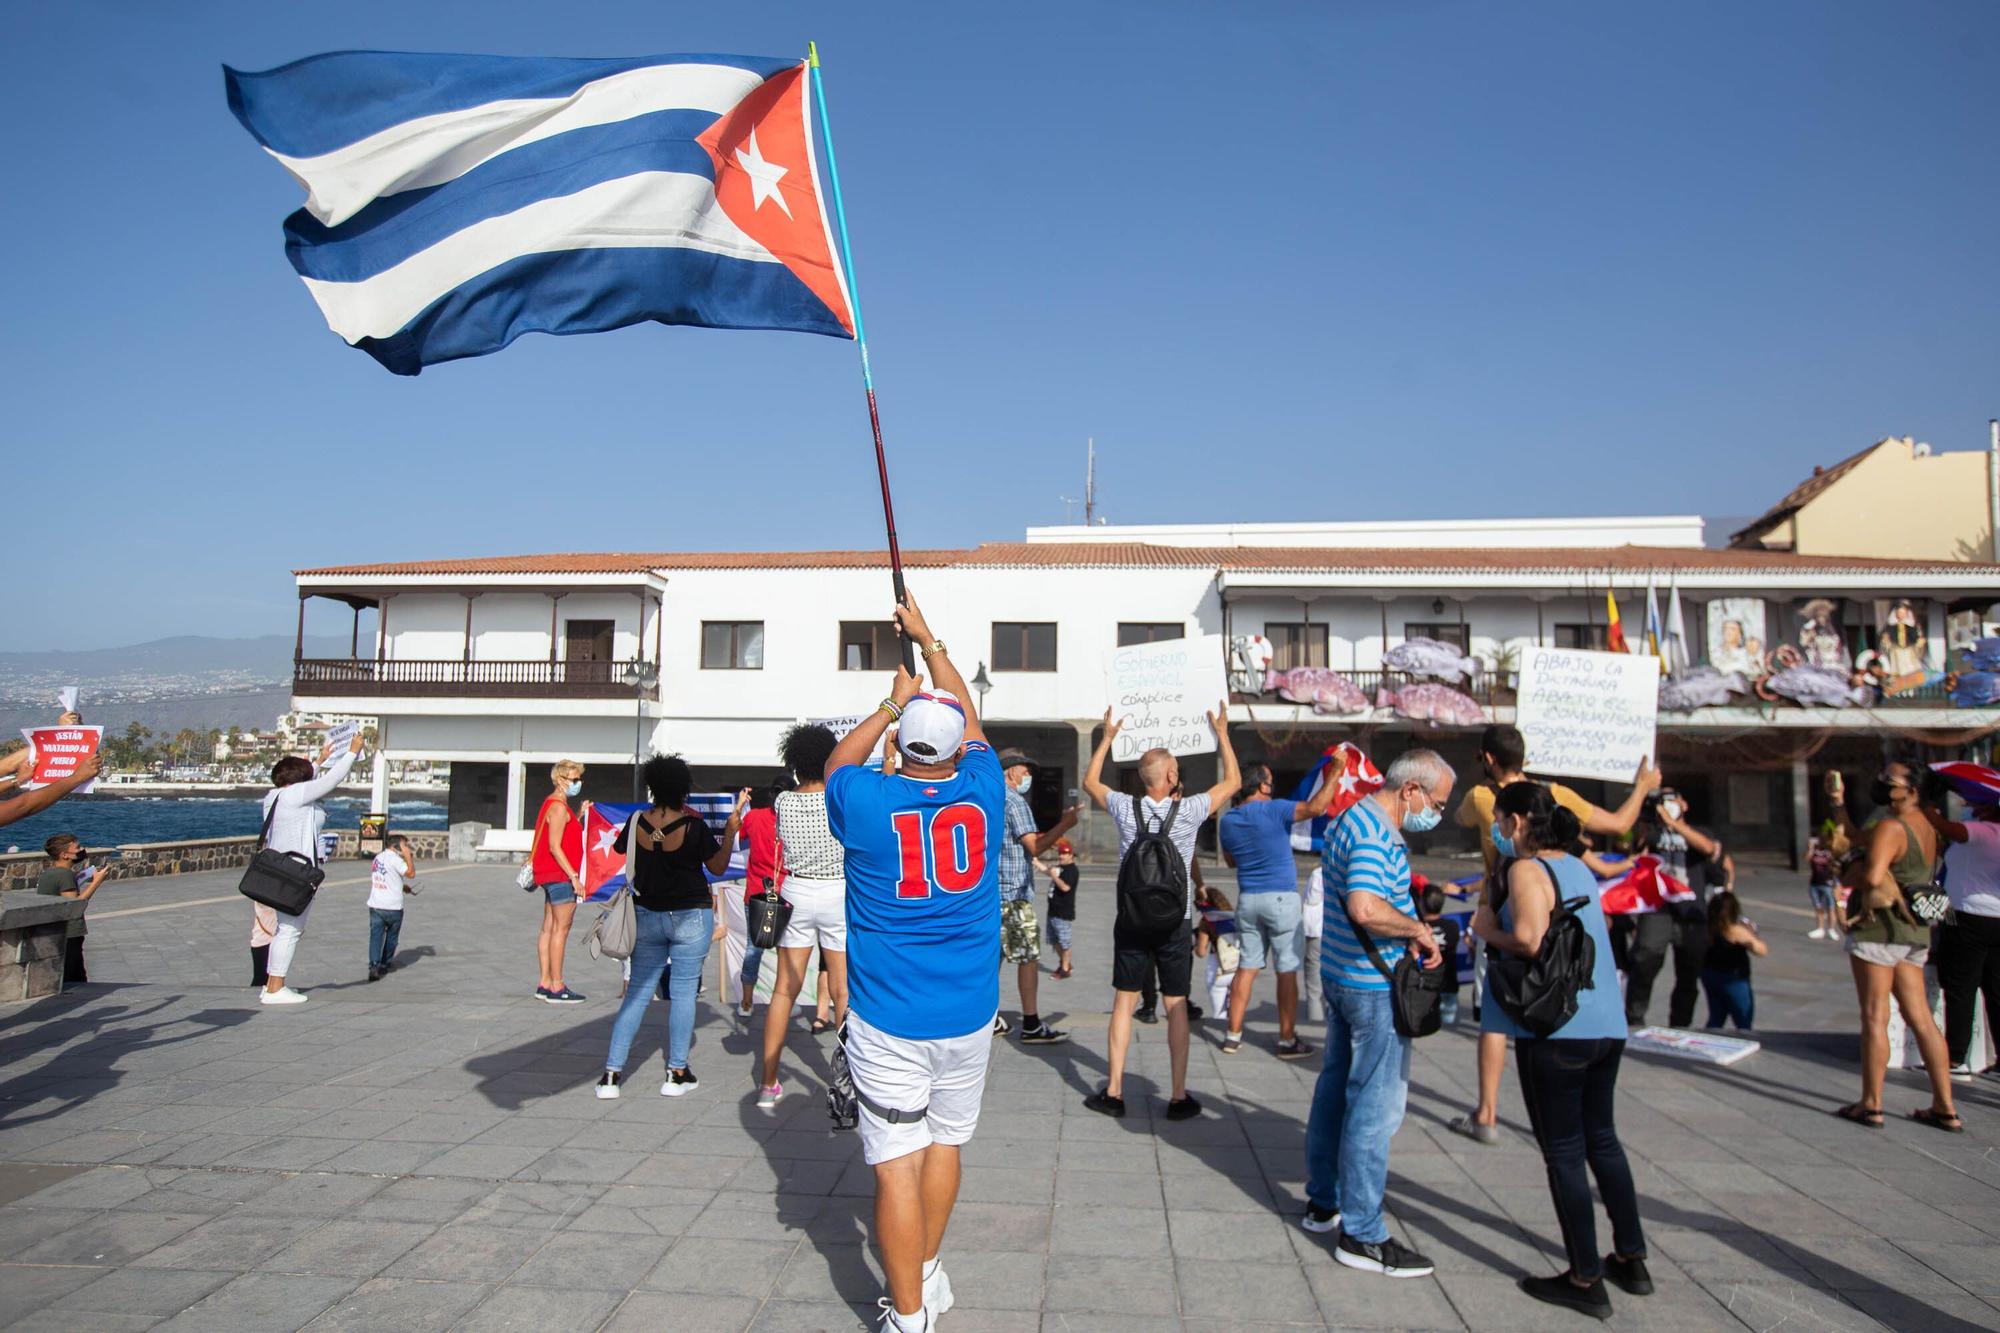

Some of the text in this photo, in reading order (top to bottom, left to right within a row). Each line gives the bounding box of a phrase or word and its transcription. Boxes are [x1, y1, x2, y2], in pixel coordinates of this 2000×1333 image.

[1534, 652, 1594, 672] ABAJO
[1531, 687, 1597, 708] ABAJO
[43, 744, 79, 753] MATANDO
[891, 802, 988, 899] 10
